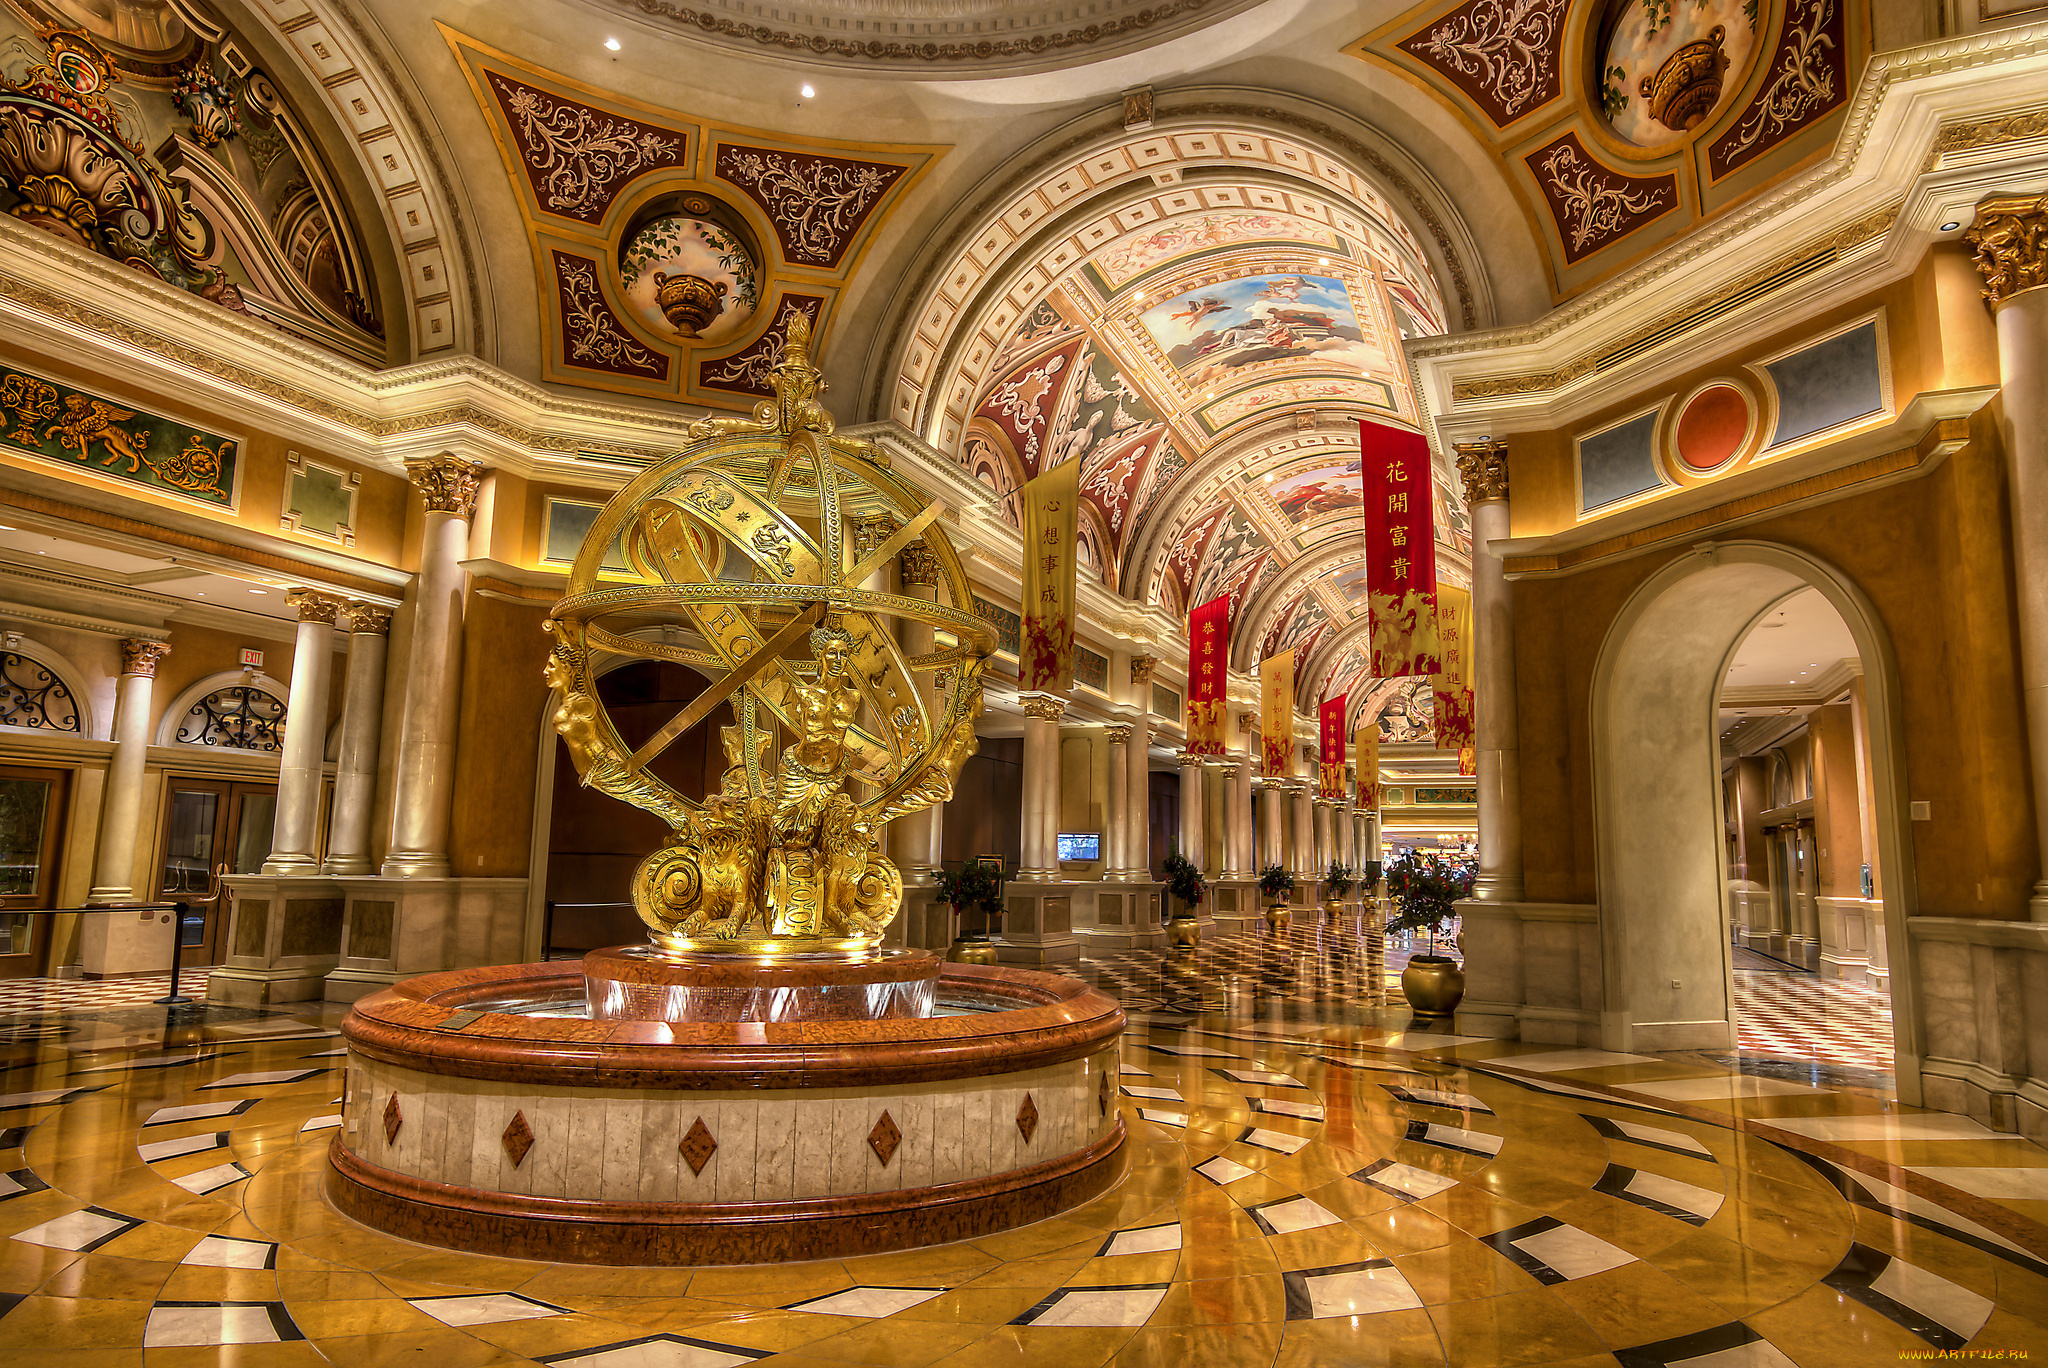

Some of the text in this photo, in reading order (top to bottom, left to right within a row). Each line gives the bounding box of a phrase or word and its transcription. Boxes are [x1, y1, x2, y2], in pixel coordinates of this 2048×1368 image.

[1040, 500, 1061, 604] 心想事成
[1385, 460, 1412, 581] 花開富貴
[244, 650, 262, 665] EXIT
[1201, 620, 1215, 695] 恭喜發財
[1441, 606, 1462, 685] 財源廣進
[1272, 671, 1283, 732] 萬事如意
